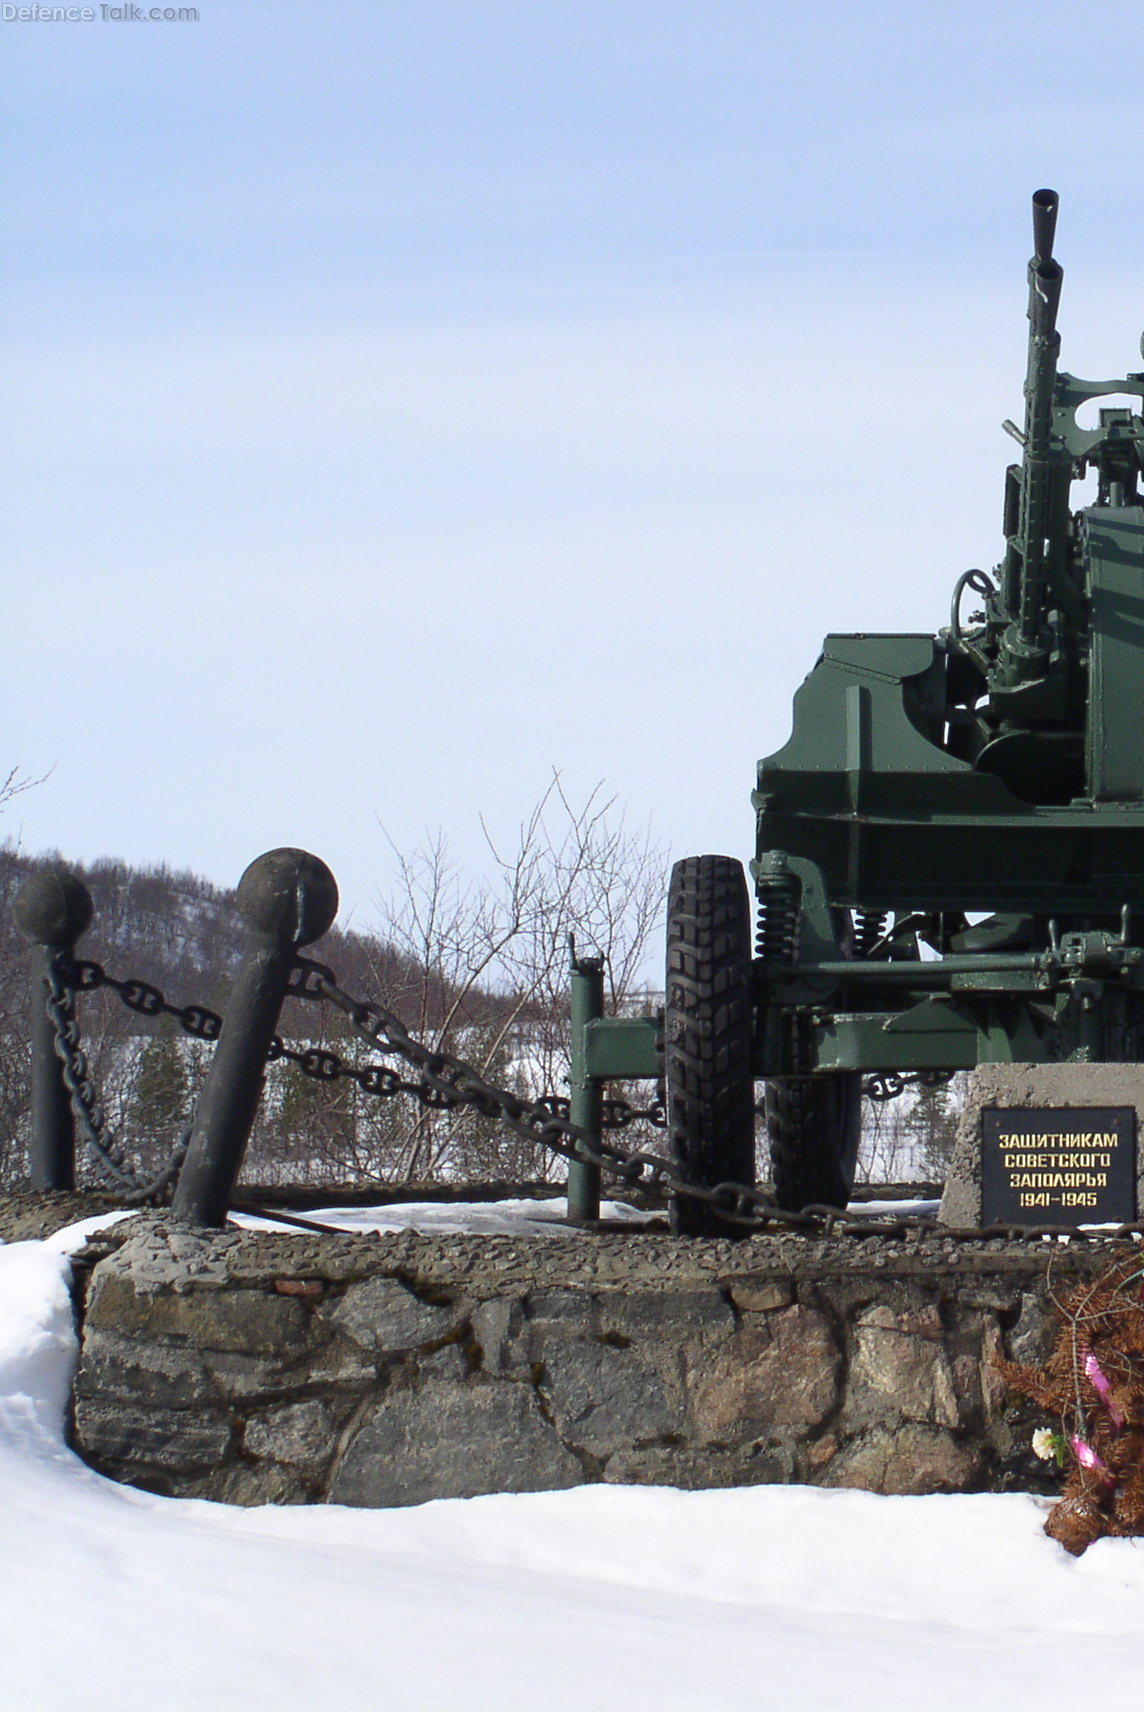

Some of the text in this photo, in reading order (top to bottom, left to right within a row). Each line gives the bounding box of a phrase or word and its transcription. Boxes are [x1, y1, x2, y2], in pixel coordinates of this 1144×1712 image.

[1005, 1153, 1111, 1168] СОВЕТСКОГО
[1010, 1173, 1107, 1187] ЗАПОЛЯРЬЯ
[1020, 1192, 1097, 1207] 1941-1945
